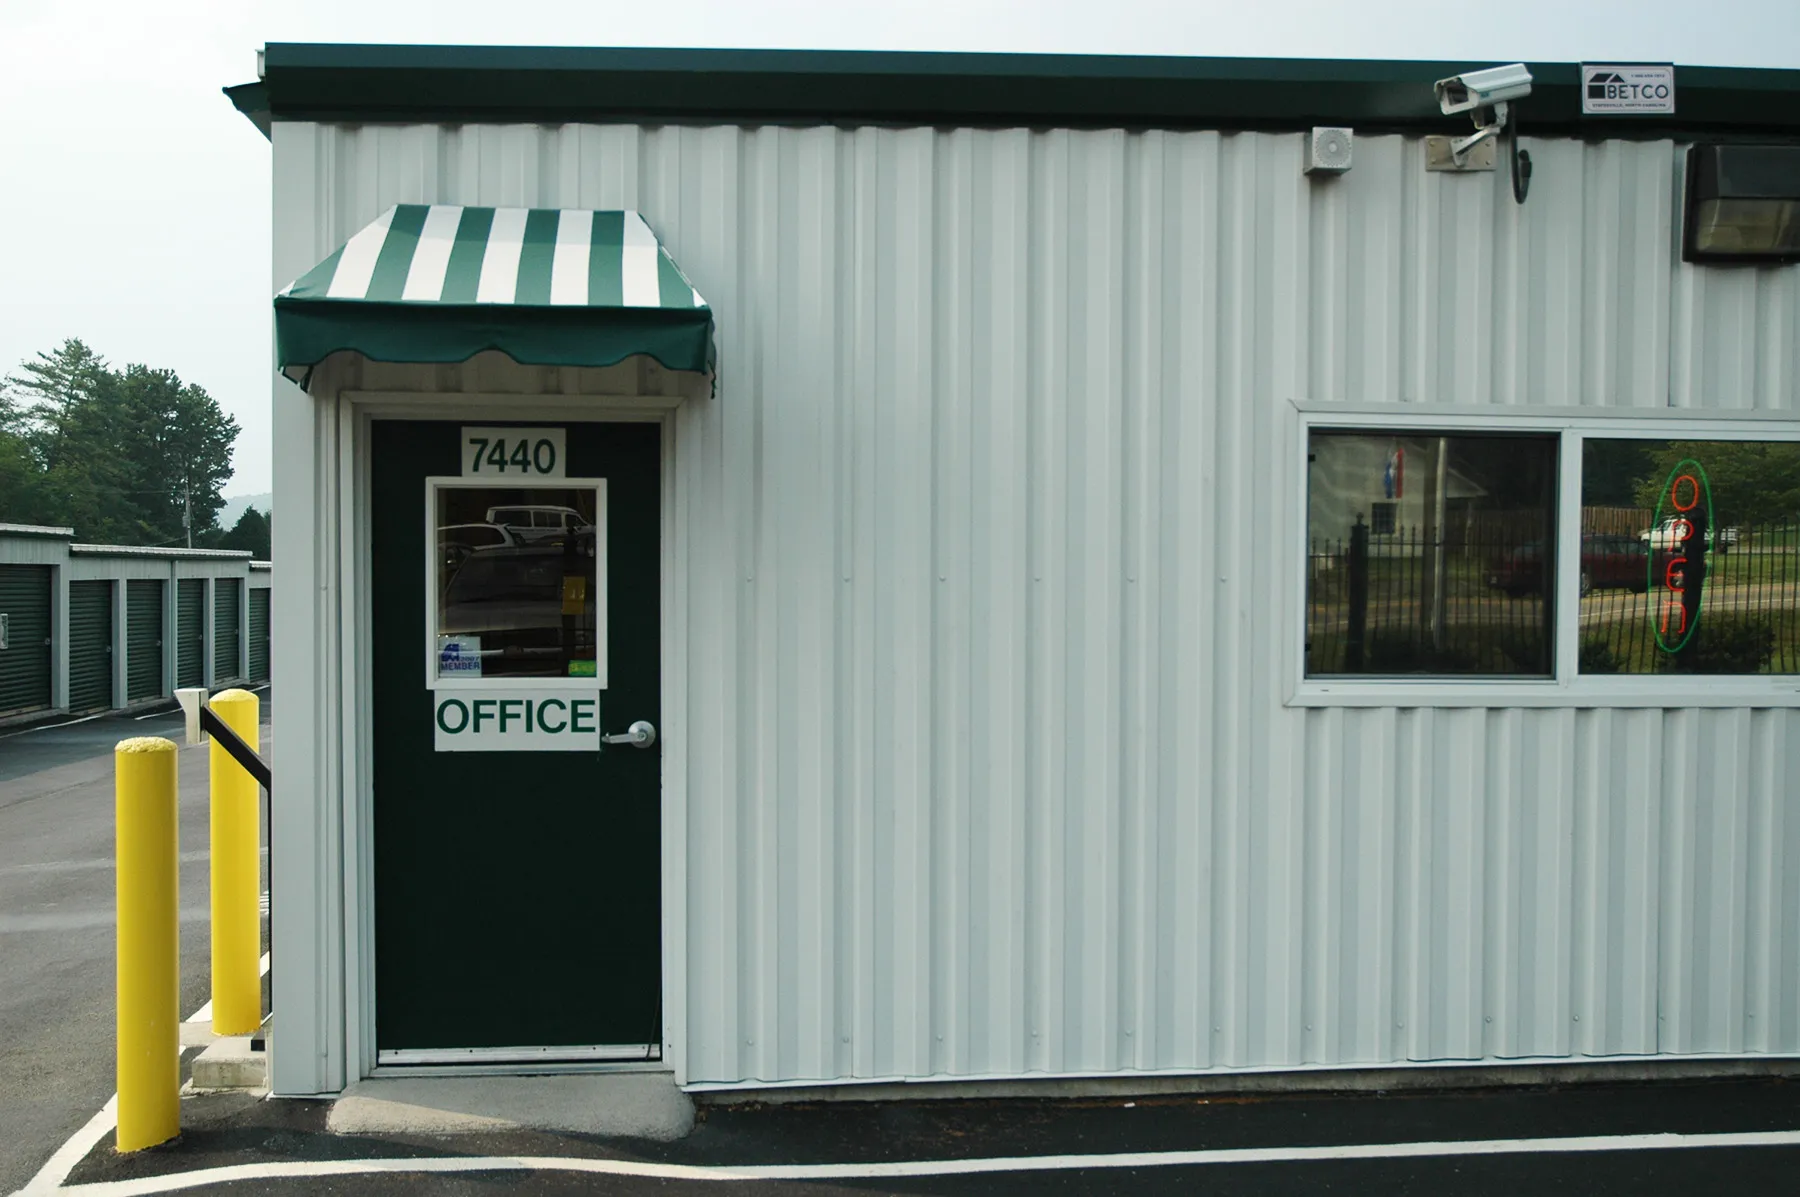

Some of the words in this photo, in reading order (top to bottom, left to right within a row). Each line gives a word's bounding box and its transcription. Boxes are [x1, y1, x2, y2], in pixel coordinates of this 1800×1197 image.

[1607, 84, 1669, 99] BETCO
[469, 438, 556, 474] 7440
[440, 661, 480, 671] MEMBER
[437, 698, 596, 734] OFFICE
